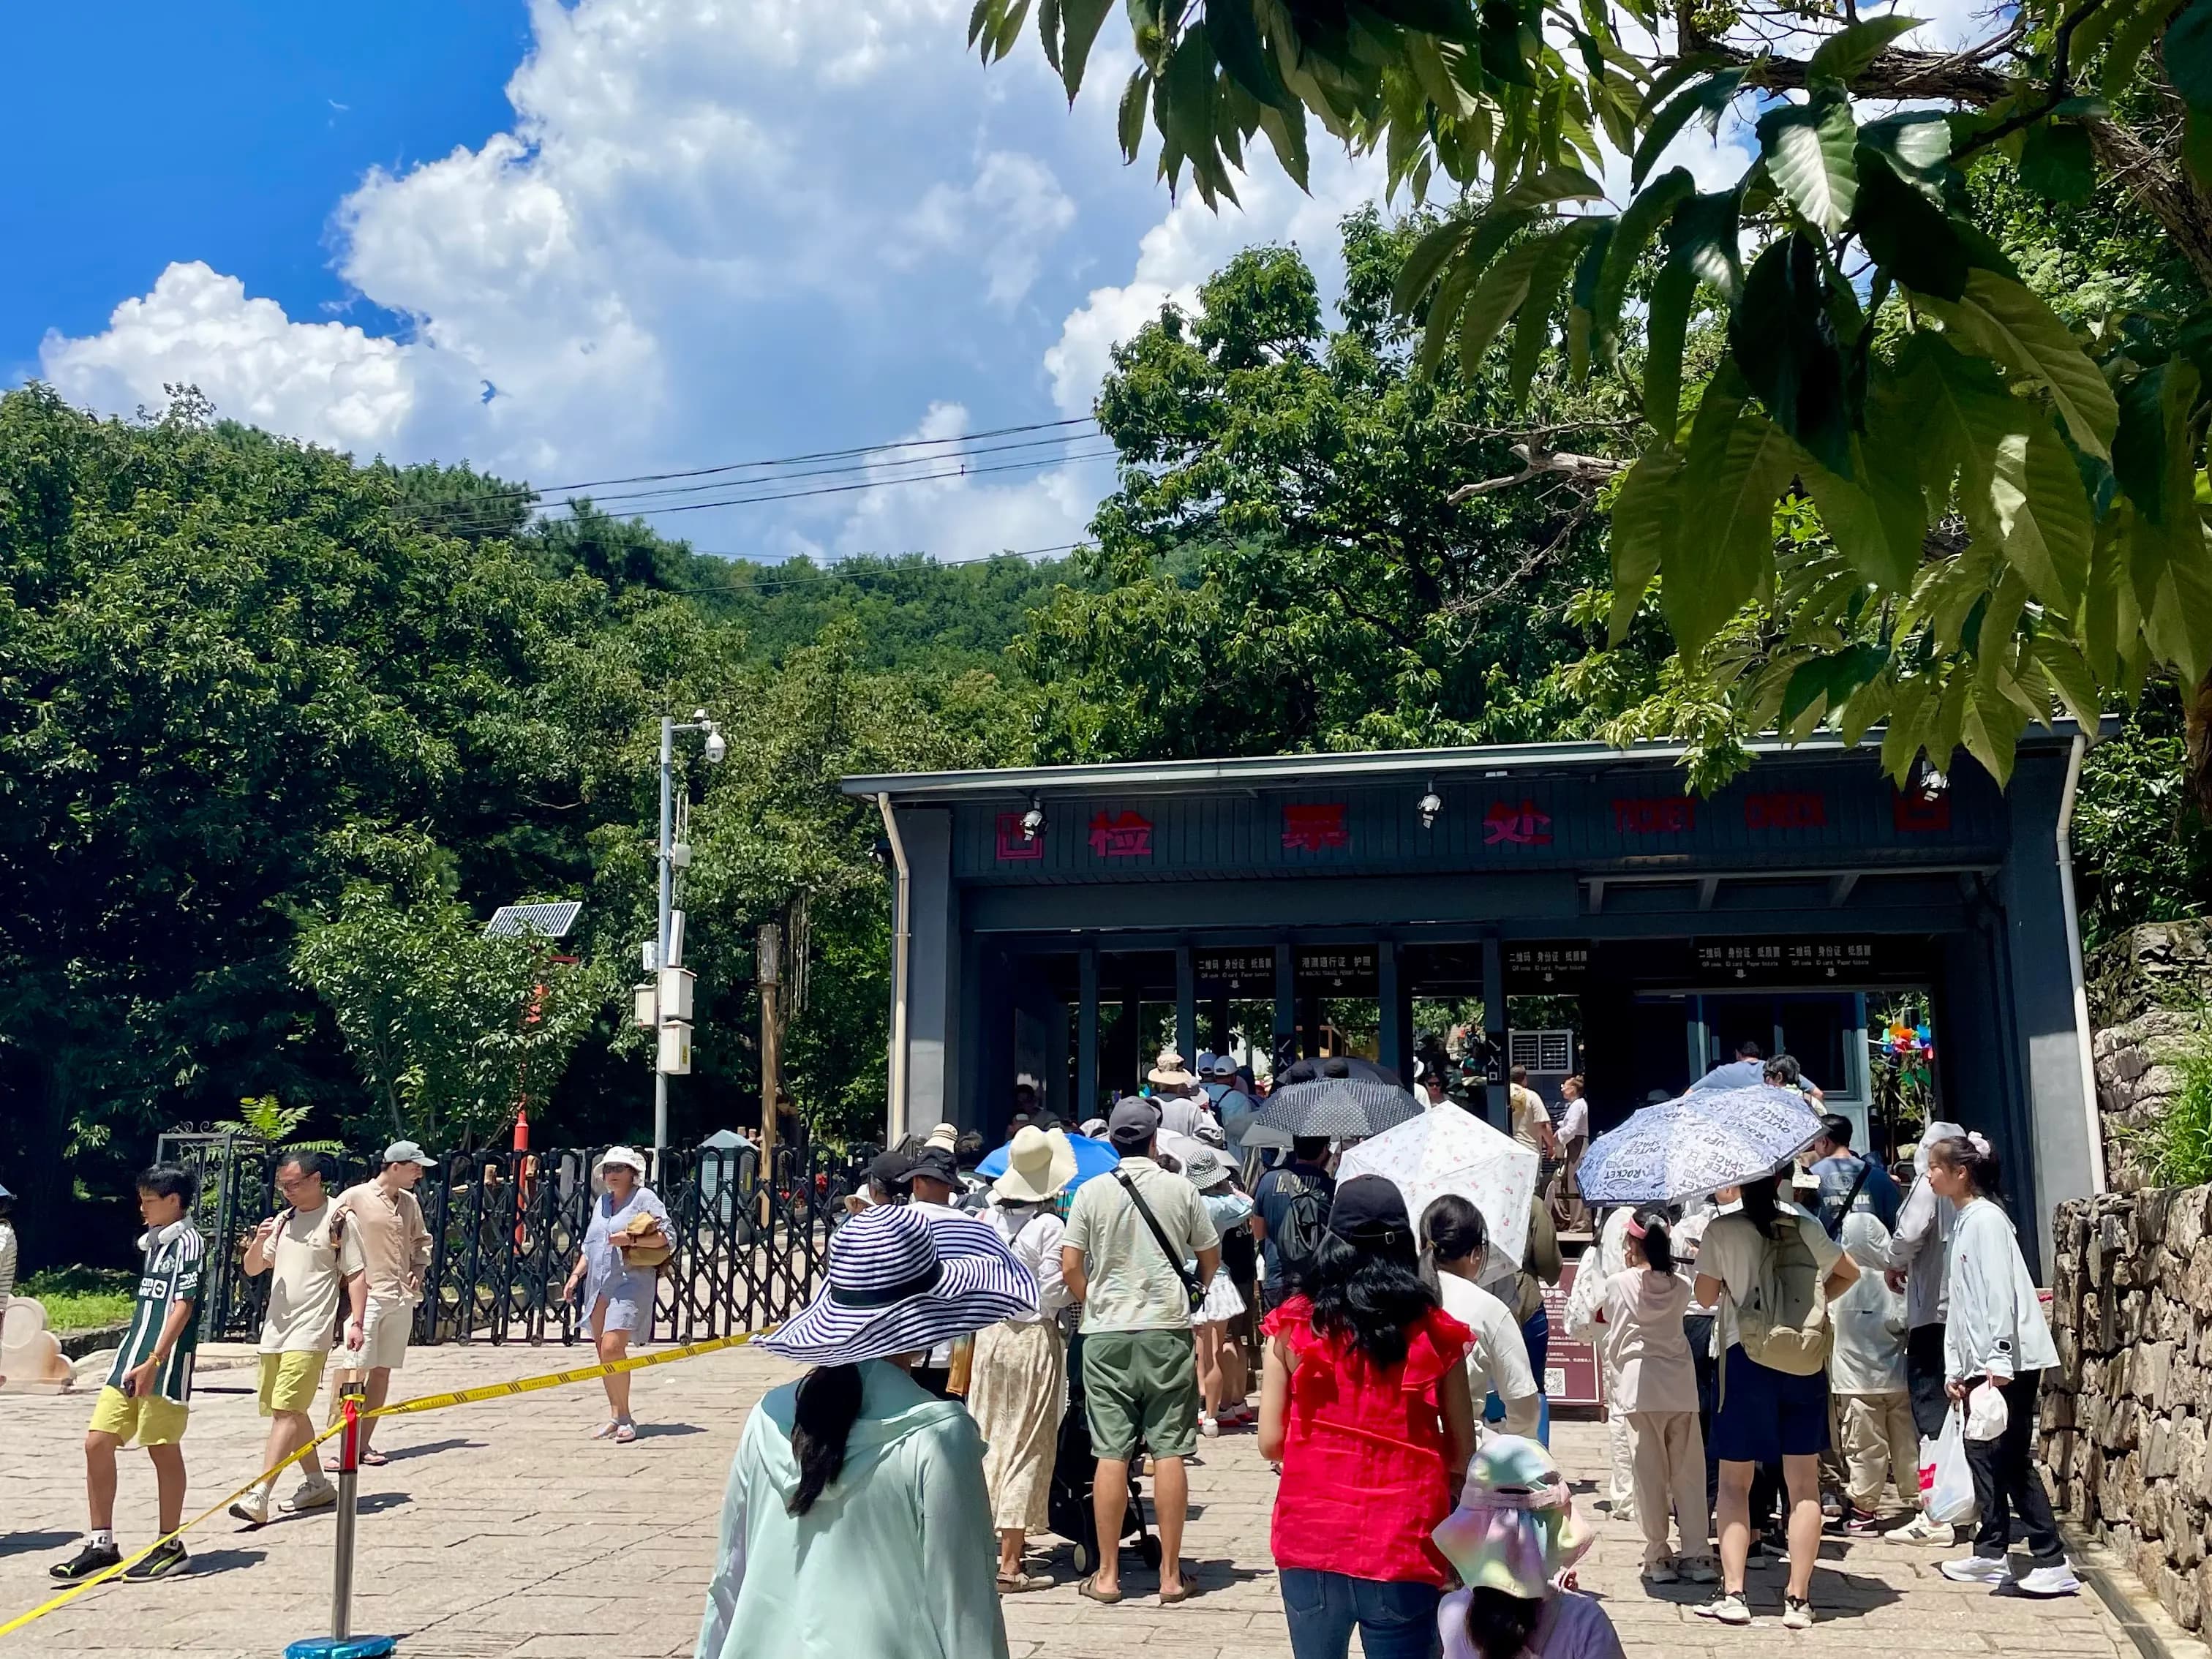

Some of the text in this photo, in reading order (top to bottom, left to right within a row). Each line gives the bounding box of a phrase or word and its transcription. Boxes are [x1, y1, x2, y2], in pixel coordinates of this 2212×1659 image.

[1612, 794, 1828, 832] TICKET CHECK
[1488, 1056, 1498, 1081] 入口
[1750, 1112, 1791, 1134] OUTER
[1624, 1146, 1661, 1156] OUTER
[1703, 1137, 1726, 1148] UFO
[1704, 1160, 1737, 1180] UTER
[1709, 1151, 1745, 1172] SPACE
[1603, 1169, 1642, 1179] ROCKET
